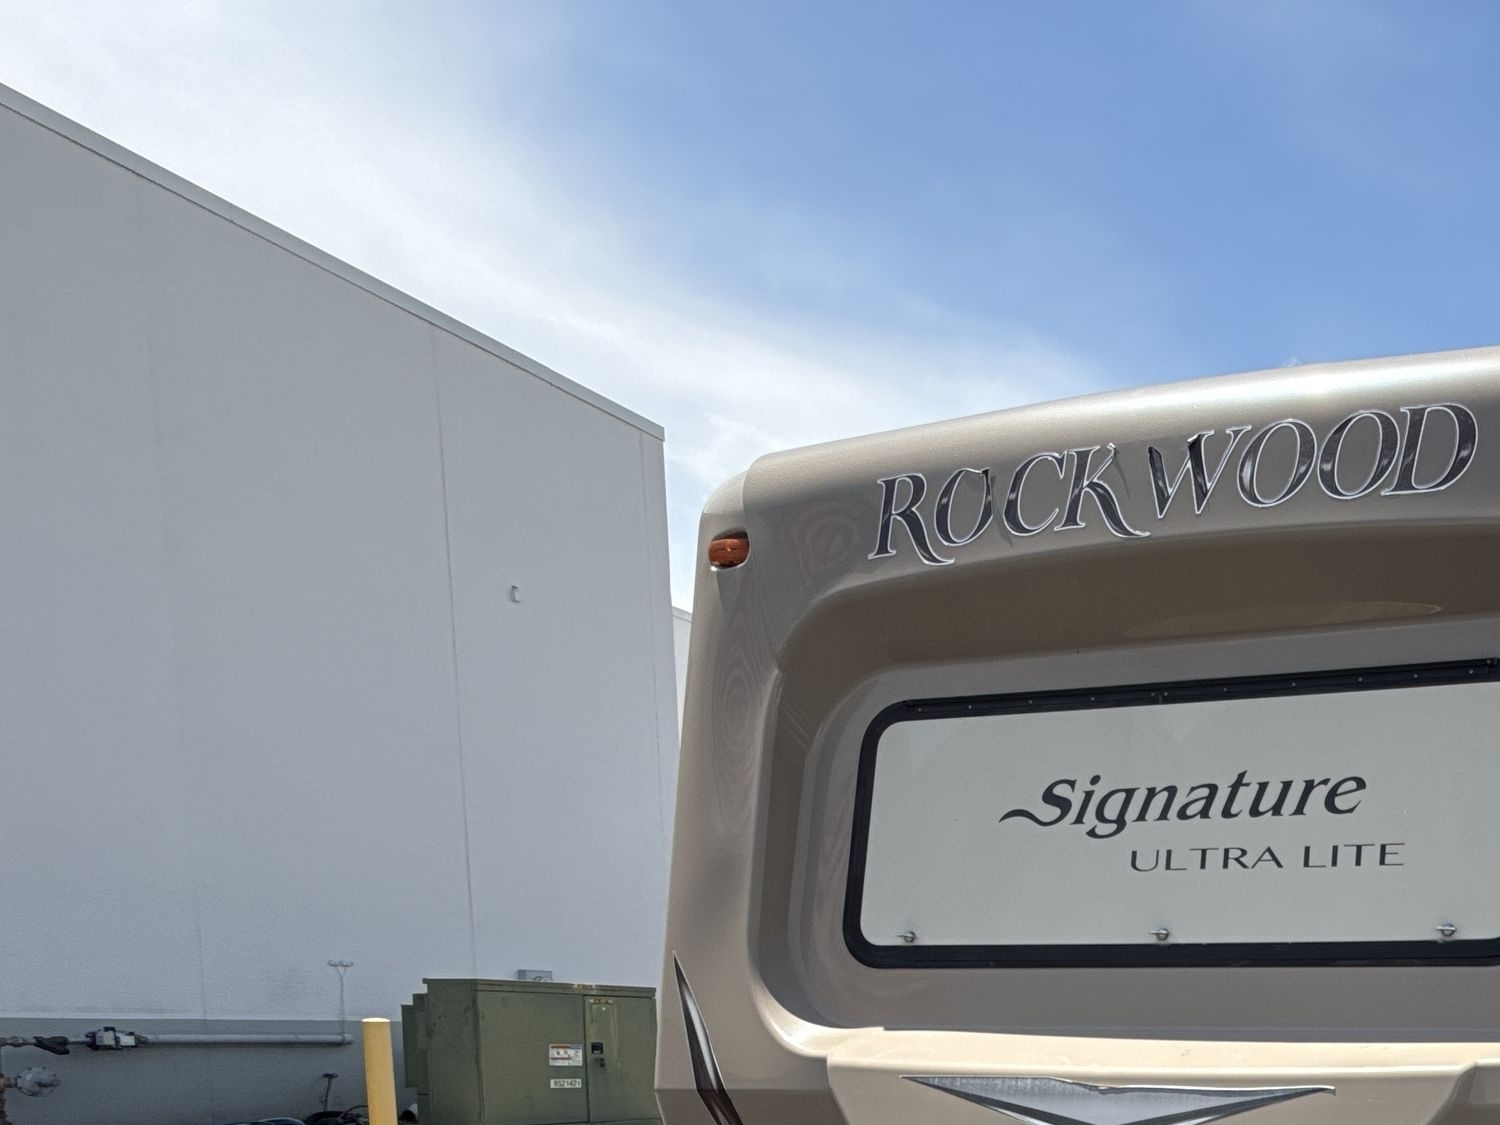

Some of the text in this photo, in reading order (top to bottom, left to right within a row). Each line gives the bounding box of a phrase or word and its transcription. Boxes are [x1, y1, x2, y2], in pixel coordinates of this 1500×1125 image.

[867, 403, 1478, 565] ROCKWOOD
[999, 770, 1367, 839] Signature
[1130, 842, 1406, 872] ULTRA LITE
